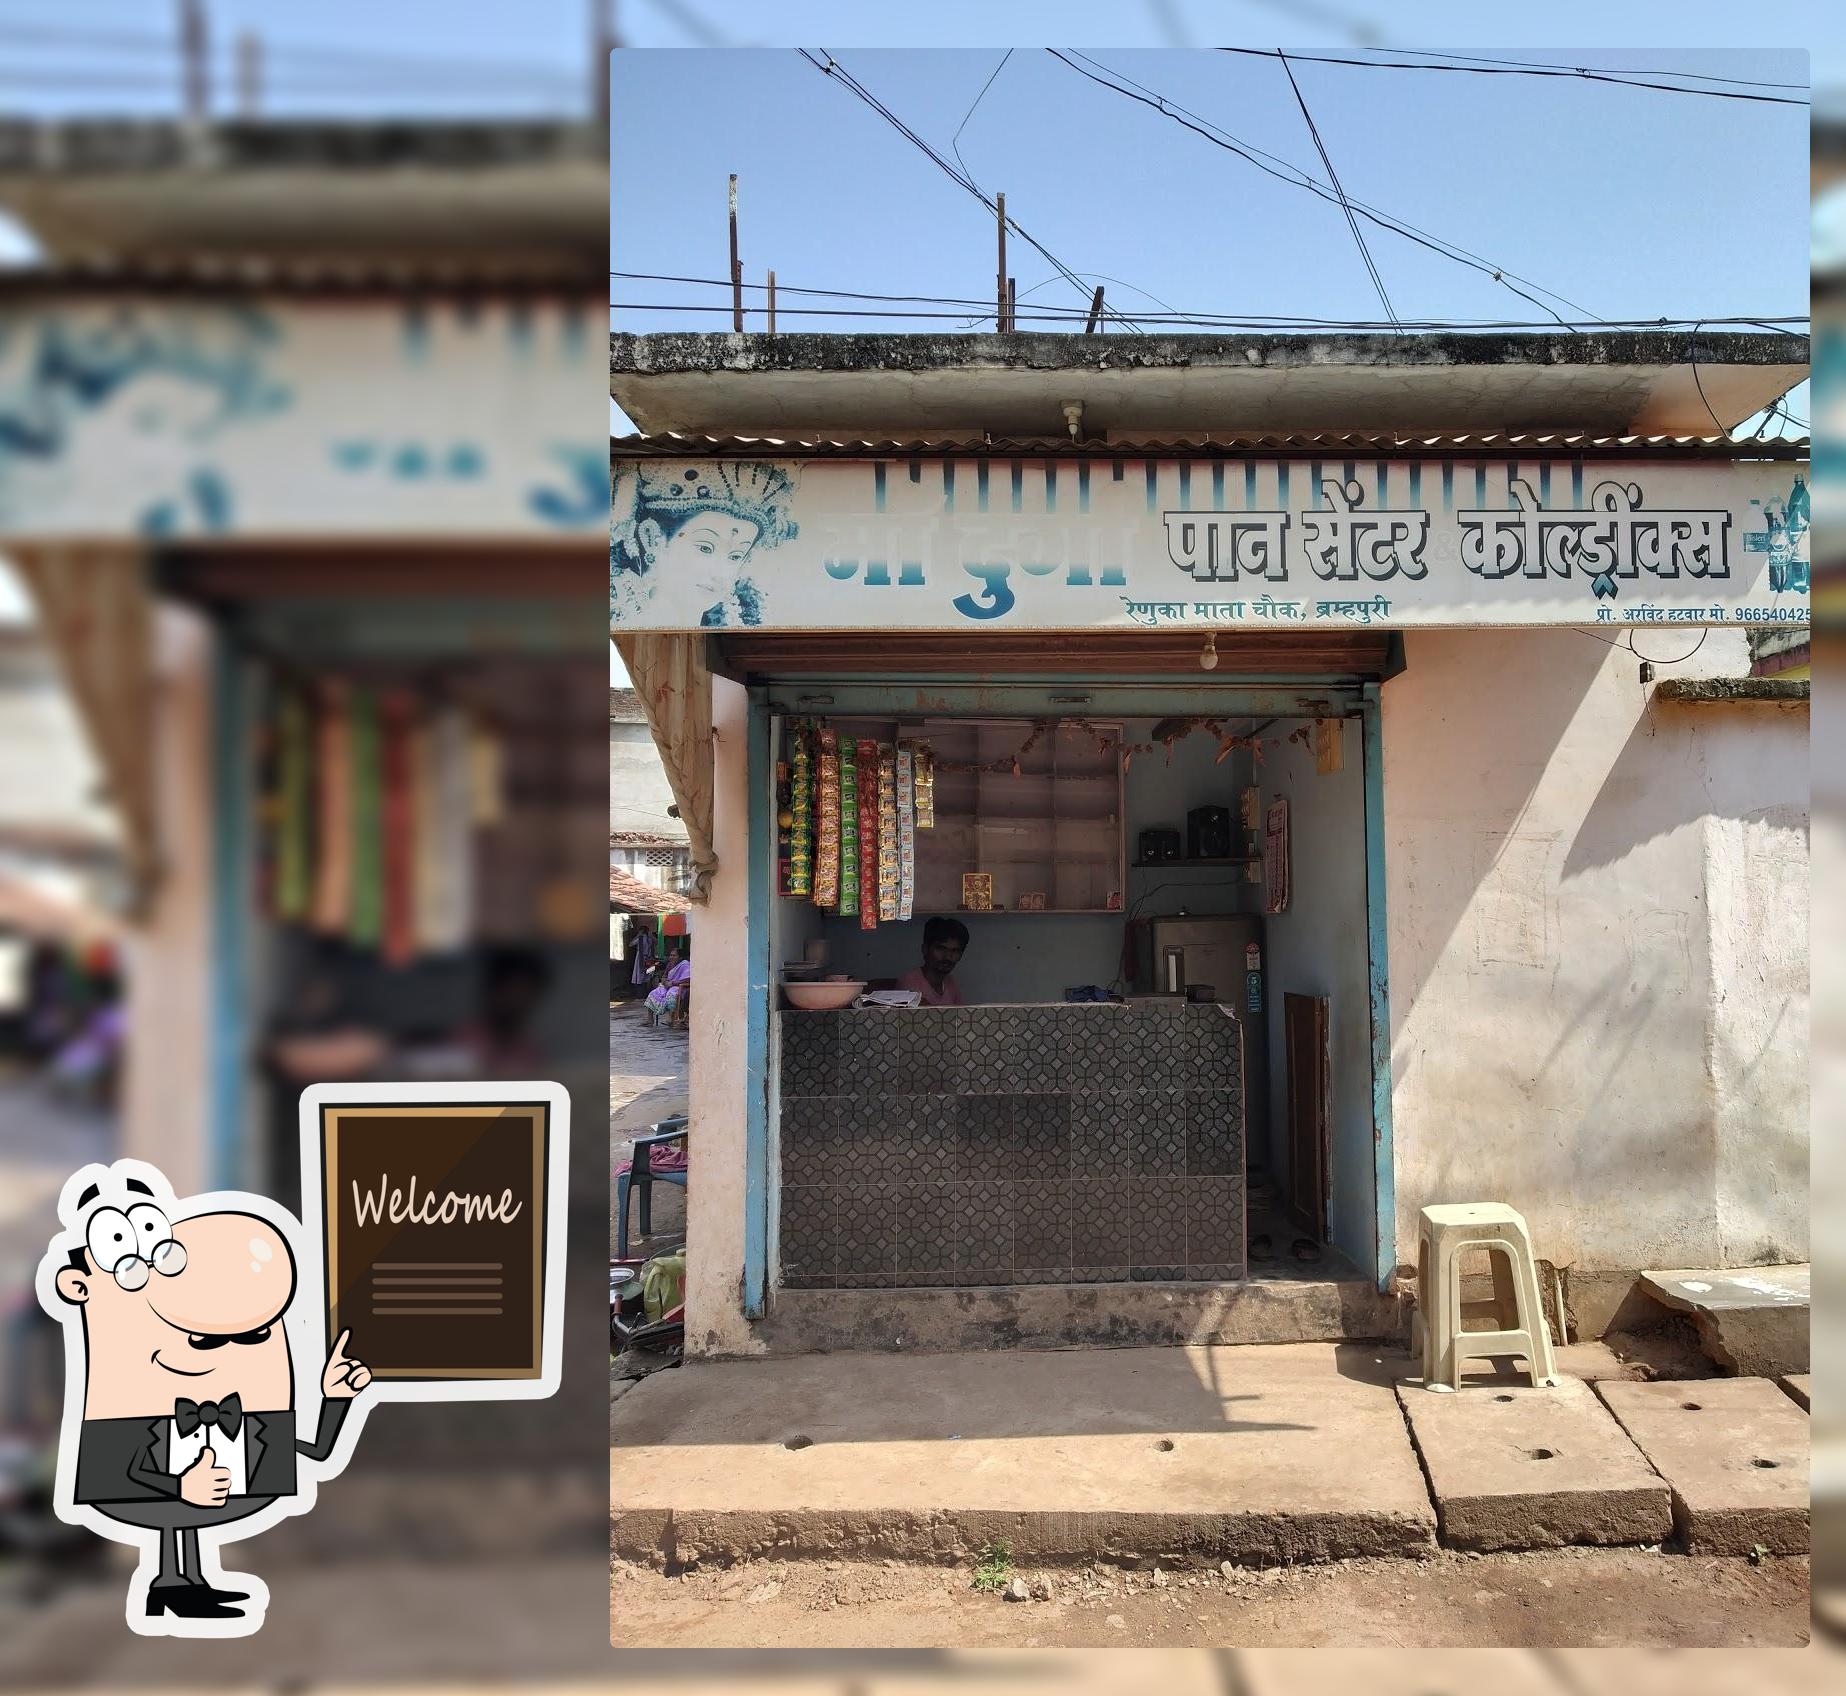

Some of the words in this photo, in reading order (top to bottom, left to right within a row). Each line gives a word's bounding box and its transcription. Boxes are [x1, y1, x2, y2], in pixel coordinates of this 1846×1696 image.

[1163, 511, 1291, 582] पान
[1301, 479, 1431, 581] सेंटर
[1119, 595, 1188, 625] रेणुका
[1194, 601, 1247, 620] माता
[1252, 594, 1307, 622] चौक,
[1316, 594, 1392, 624] ब्रम्हपुरी
[1596, 603, 1616, 621] प्रो.
[1623, 603, 1665, 621] अरविंद
[1668, 608, 1706, 621] हटवार
[1709, 603, 1730, 621] मो.
